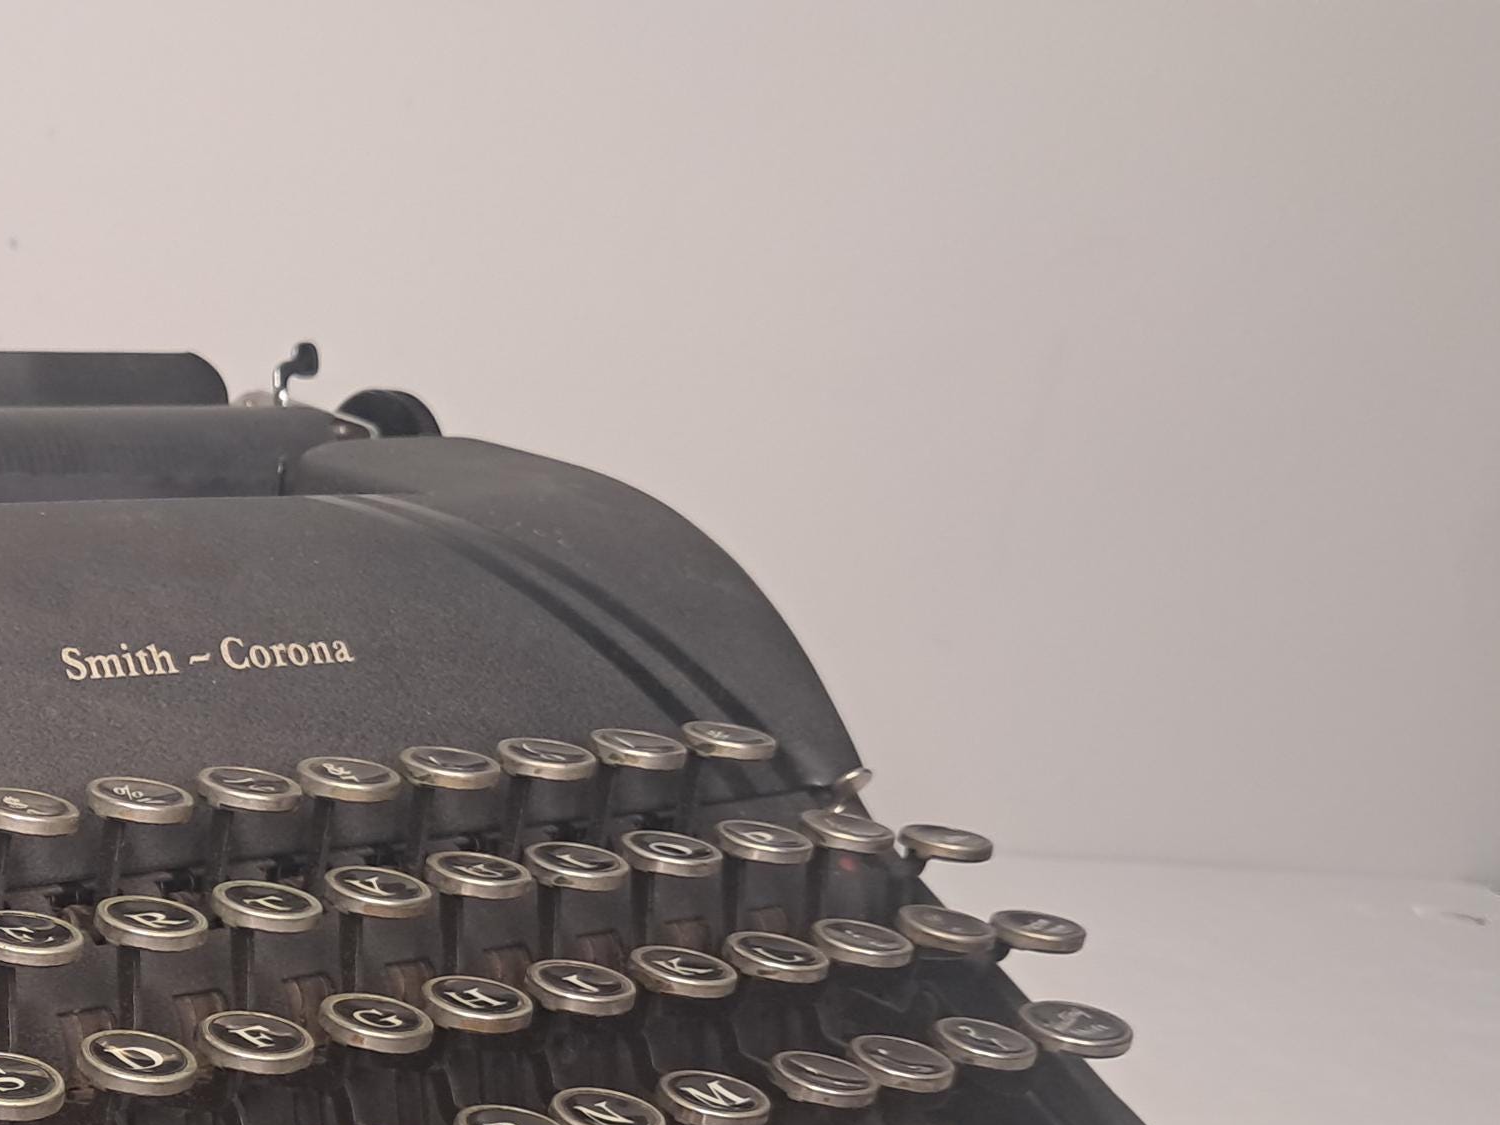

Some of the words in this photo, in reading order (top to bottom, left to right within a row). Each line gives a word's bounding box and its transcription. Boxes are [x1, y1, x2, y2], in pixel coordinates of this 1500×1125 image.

[60, 642, 180, 681] Smith
[220, 636, 355, 670] Corona
[243, 895, 293, 911] T
[124, 912, 190, 929] R
[651, 957, 714, 976] K
[445, 987, 507, 1009] H
[352, 1008, 403, 1028] G
[228, 1025, 276, 1048] F
[103, 1046, 164, 1070] D
[679, 1080, 751, 1107] M
